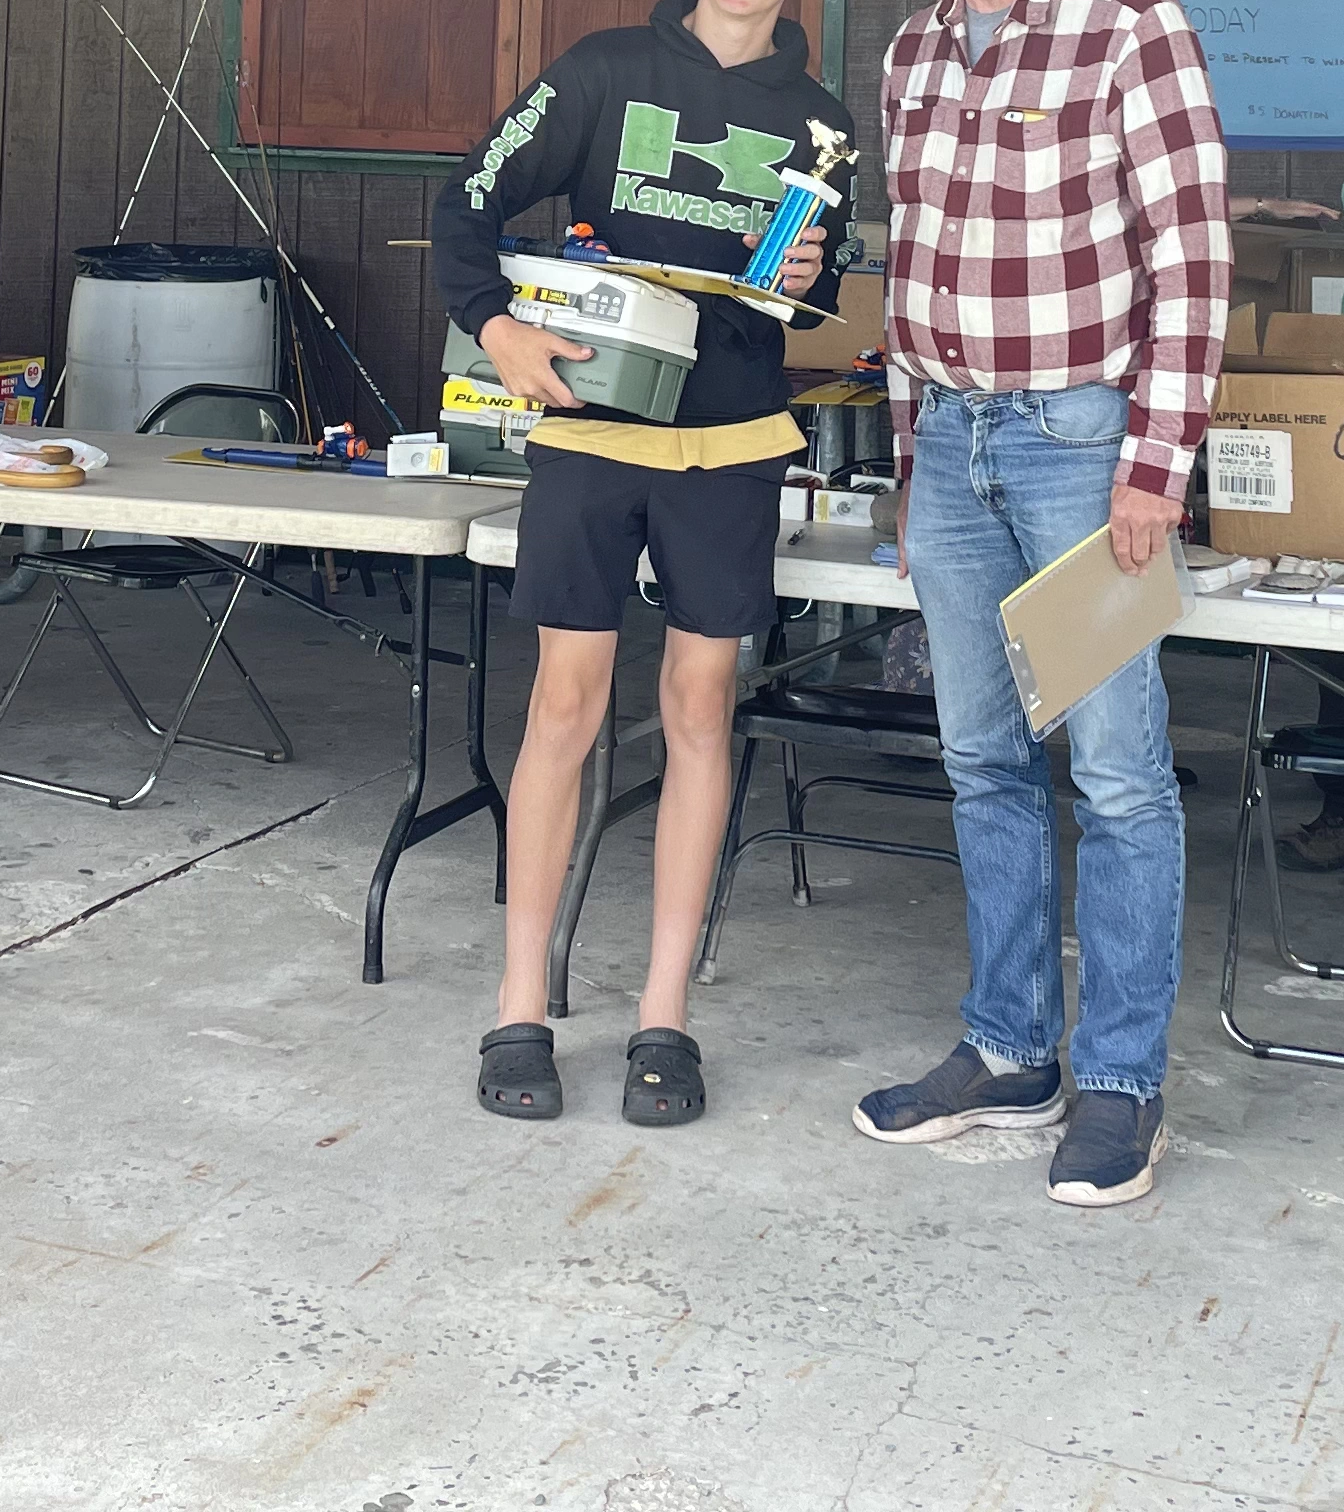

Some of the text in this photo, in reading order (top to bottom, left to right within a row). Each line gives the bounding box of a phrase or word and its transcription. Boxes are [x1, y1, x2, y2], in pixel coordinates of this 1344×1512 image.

[1183, 4, 1260, 33] ODAY
[1222, 53, 1239, 63] BE
[1242, 52, 1290, 65] PRESENT
[1301, 56, 1316, 65] TO
[1274, 106, 1329, 120] DONATION
[610, 172, 776, 235] Kawasak
[27, 366, 39, 377] 60
[1, 377, 18, 387] MINI
[576, 375, 608, 388] PLANO
[0, 386, 15, 395] MIX
[453, 393, 514, 407] PLANO
[1214, 411, 1327, 424] APPLY LABEL HERE
